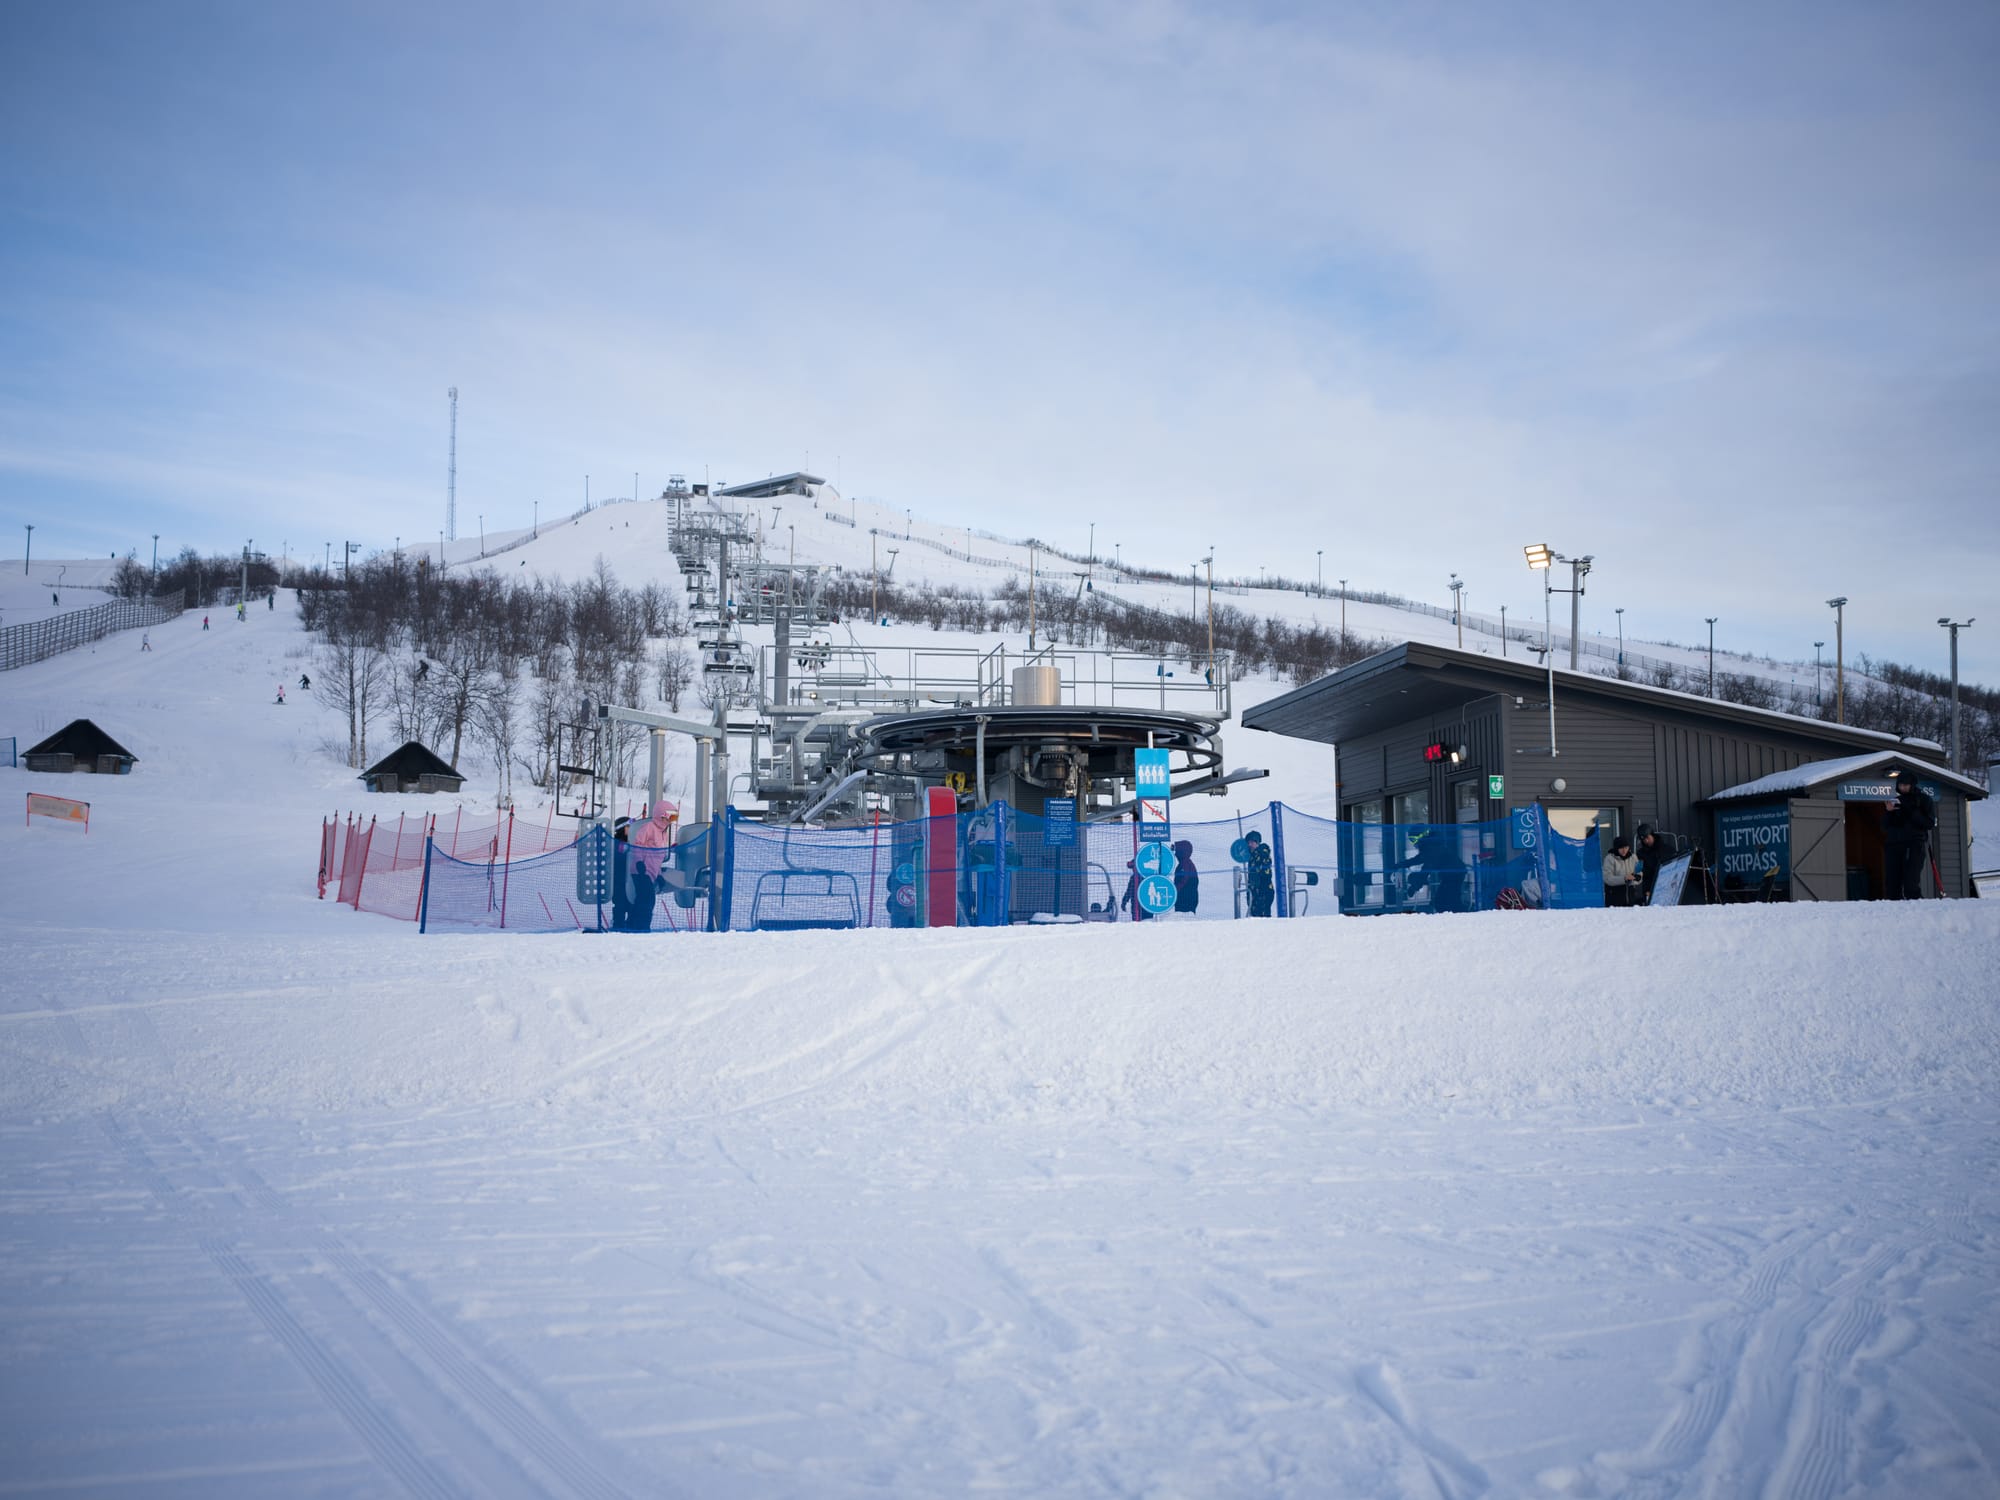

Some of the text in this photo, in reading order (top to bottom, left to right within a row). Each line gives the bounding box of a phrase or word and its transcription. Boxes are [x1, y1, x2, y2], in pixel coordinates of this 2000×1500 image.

[1843, 785, 1892, 796] LIFTKORT
[1723, 824, 1789, 848] LIFTKORT
[1723, 851, 1778, 873] SKIPASS
